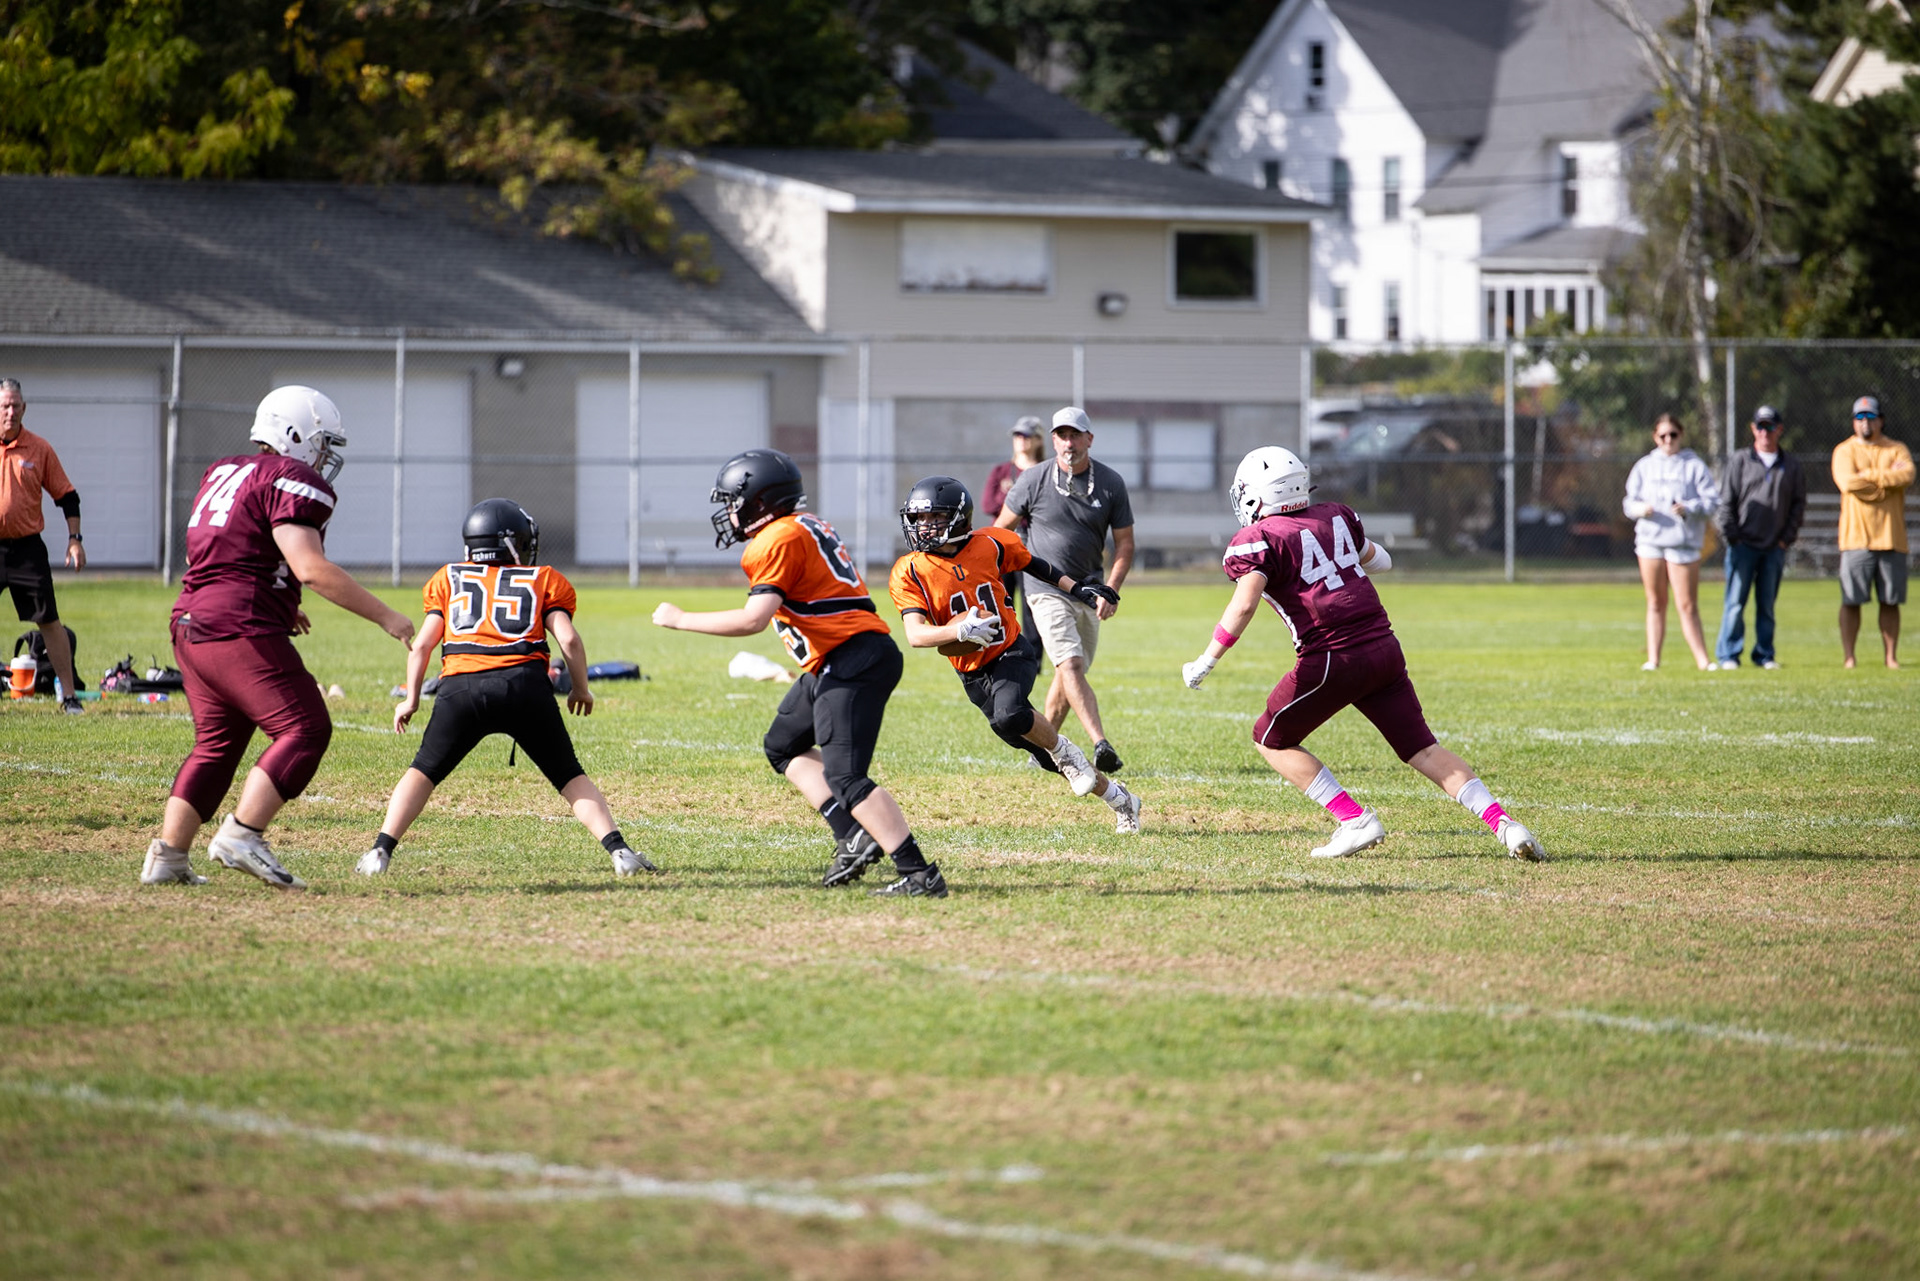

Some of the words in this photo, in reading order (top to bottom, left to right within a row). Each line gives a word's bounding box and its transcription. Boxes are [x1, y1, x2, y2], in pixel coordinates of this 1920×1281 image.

[187, 463, 257, 528] 74
[951, 563, 967, 582] U
[1300, 515, 1366, 591] 44
[446, 563, 540, 639] 55
